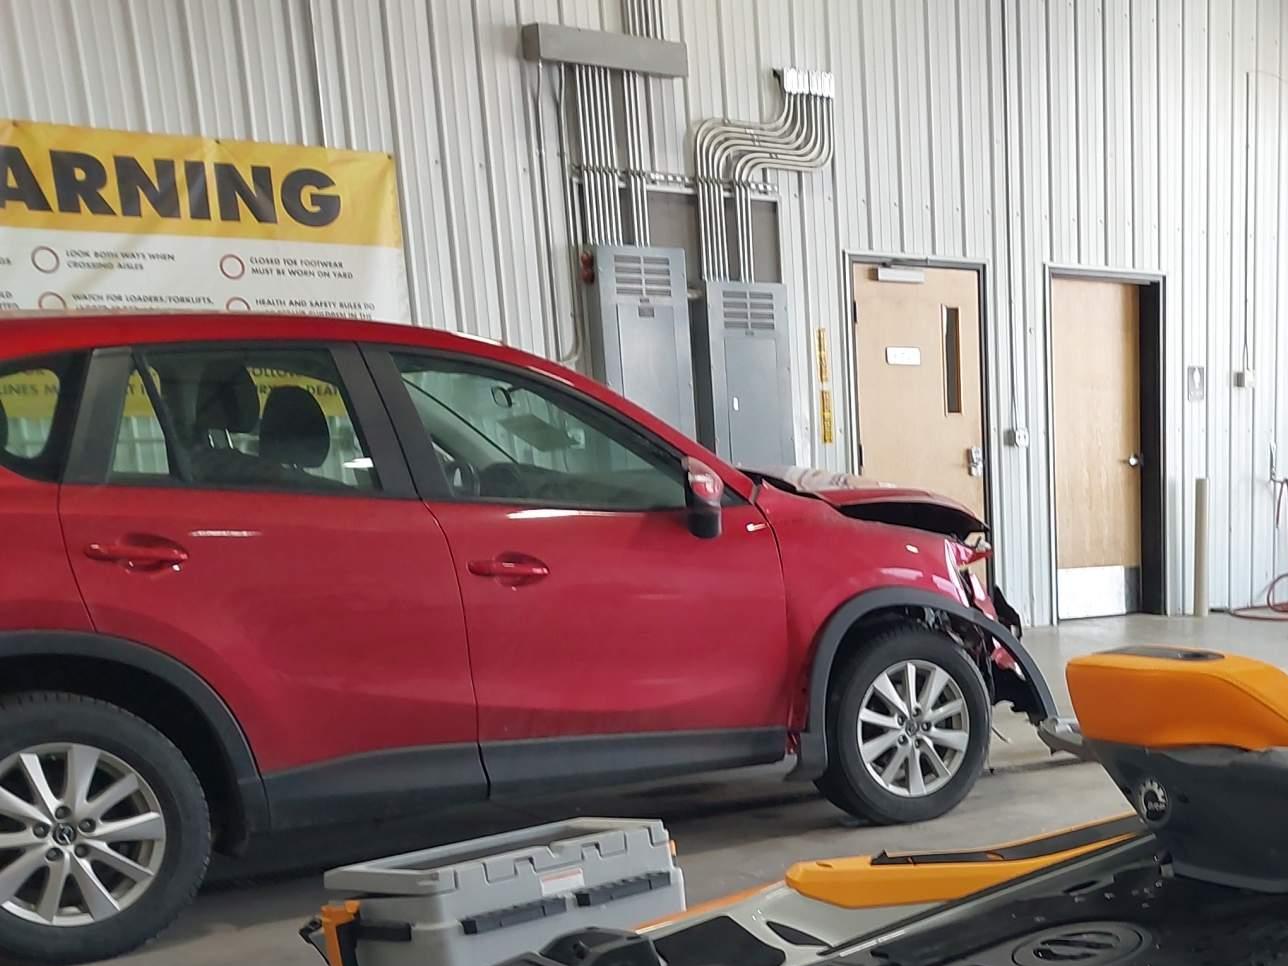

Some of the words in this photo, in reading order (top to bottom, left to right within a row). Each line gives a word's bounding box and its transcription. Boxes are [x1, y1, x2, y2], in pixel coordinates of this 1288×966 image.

[147, 252, 175, 261] WHEN
[250, 256, 280, 265] CLOSED
[300, 259, 343, 268] FOOTWEAR
[252, 267, 274, 275] MUST
[288, 269, 315, 277] WORN
[318, 270, 330, 279] ON
[332, 271, 354, 279] YARD
[256, 299, 287, 307] HEALTH
[289, 299, 307, 308] AND
[0, 385, 46, 396] INES
